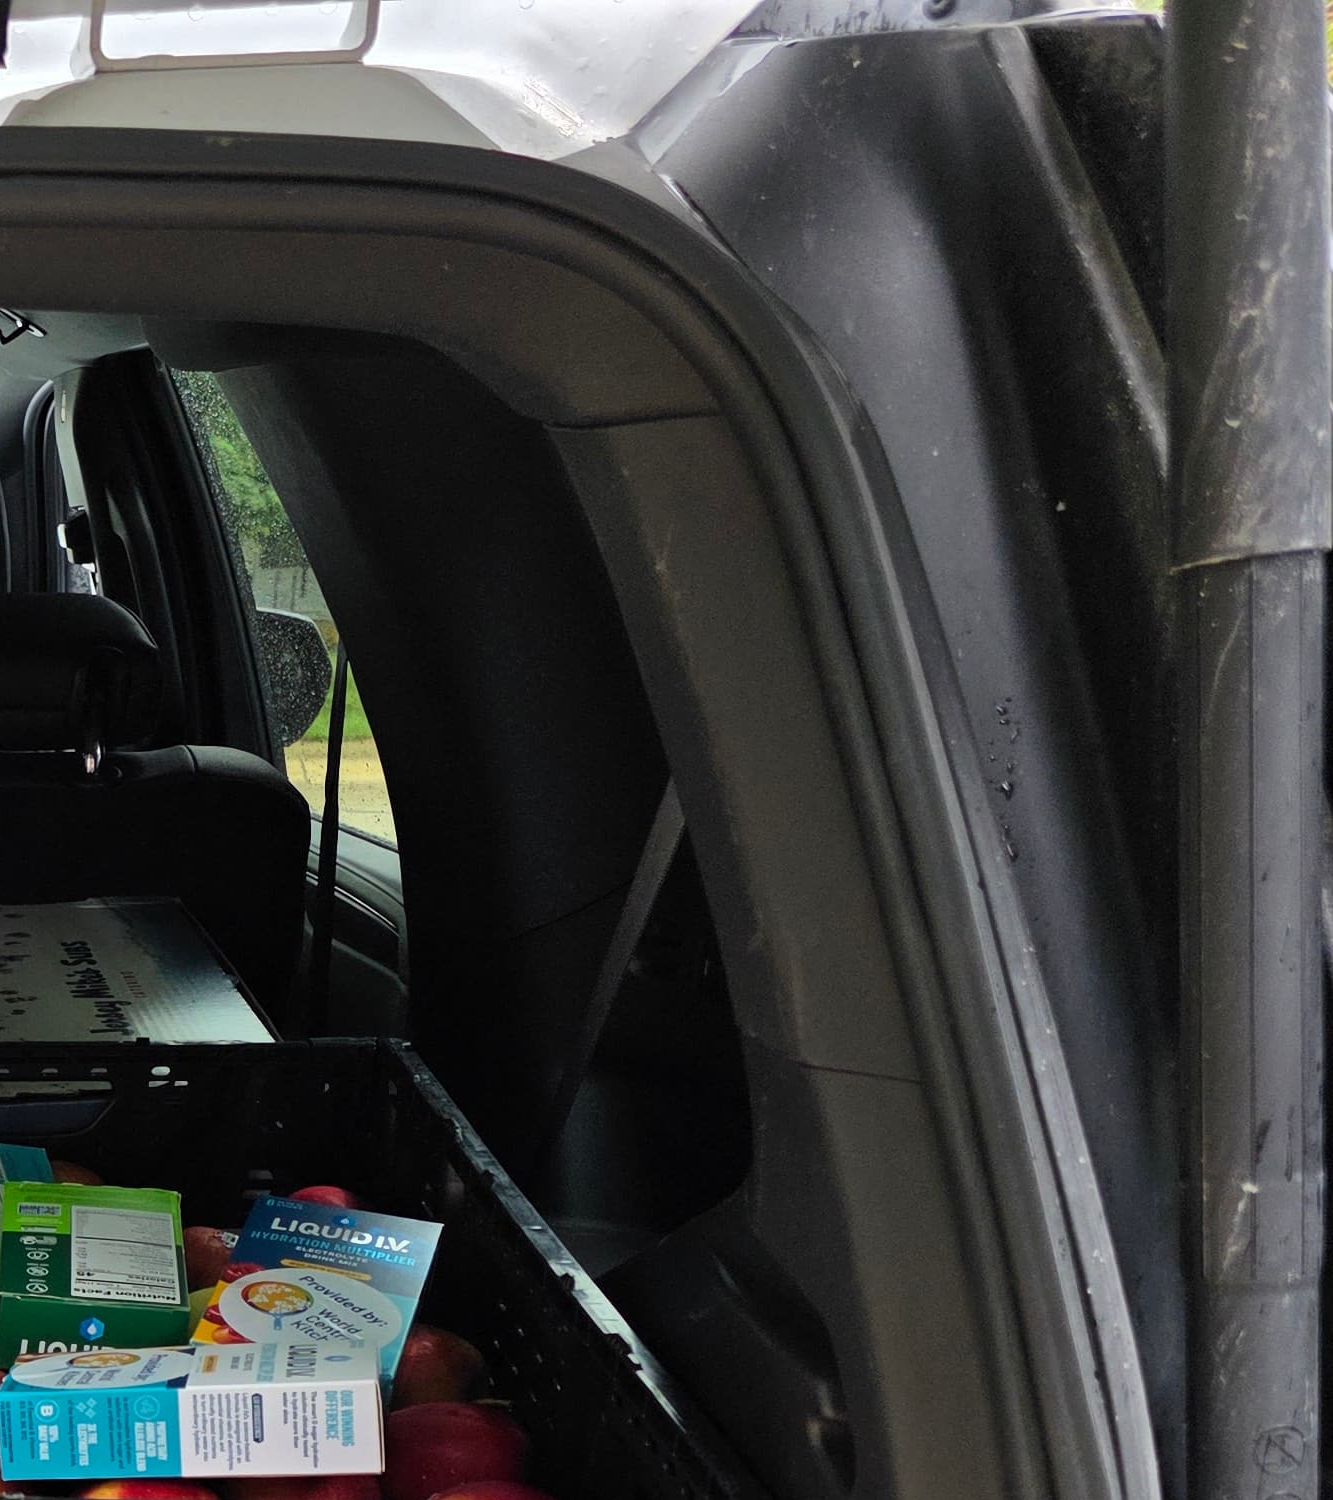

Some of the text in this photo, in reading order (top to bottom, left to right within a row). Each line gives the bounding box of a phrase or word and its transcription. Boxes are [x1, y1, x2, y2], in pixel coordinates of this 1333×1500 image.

[270, 1217, 373, 1246] LIQUID
[250, 1230, 417, 1267] HYDRATION MULTIPLIER
[298, 1274, 389, 1328] Provided by:
[318, 1306, 363, 1335] World
